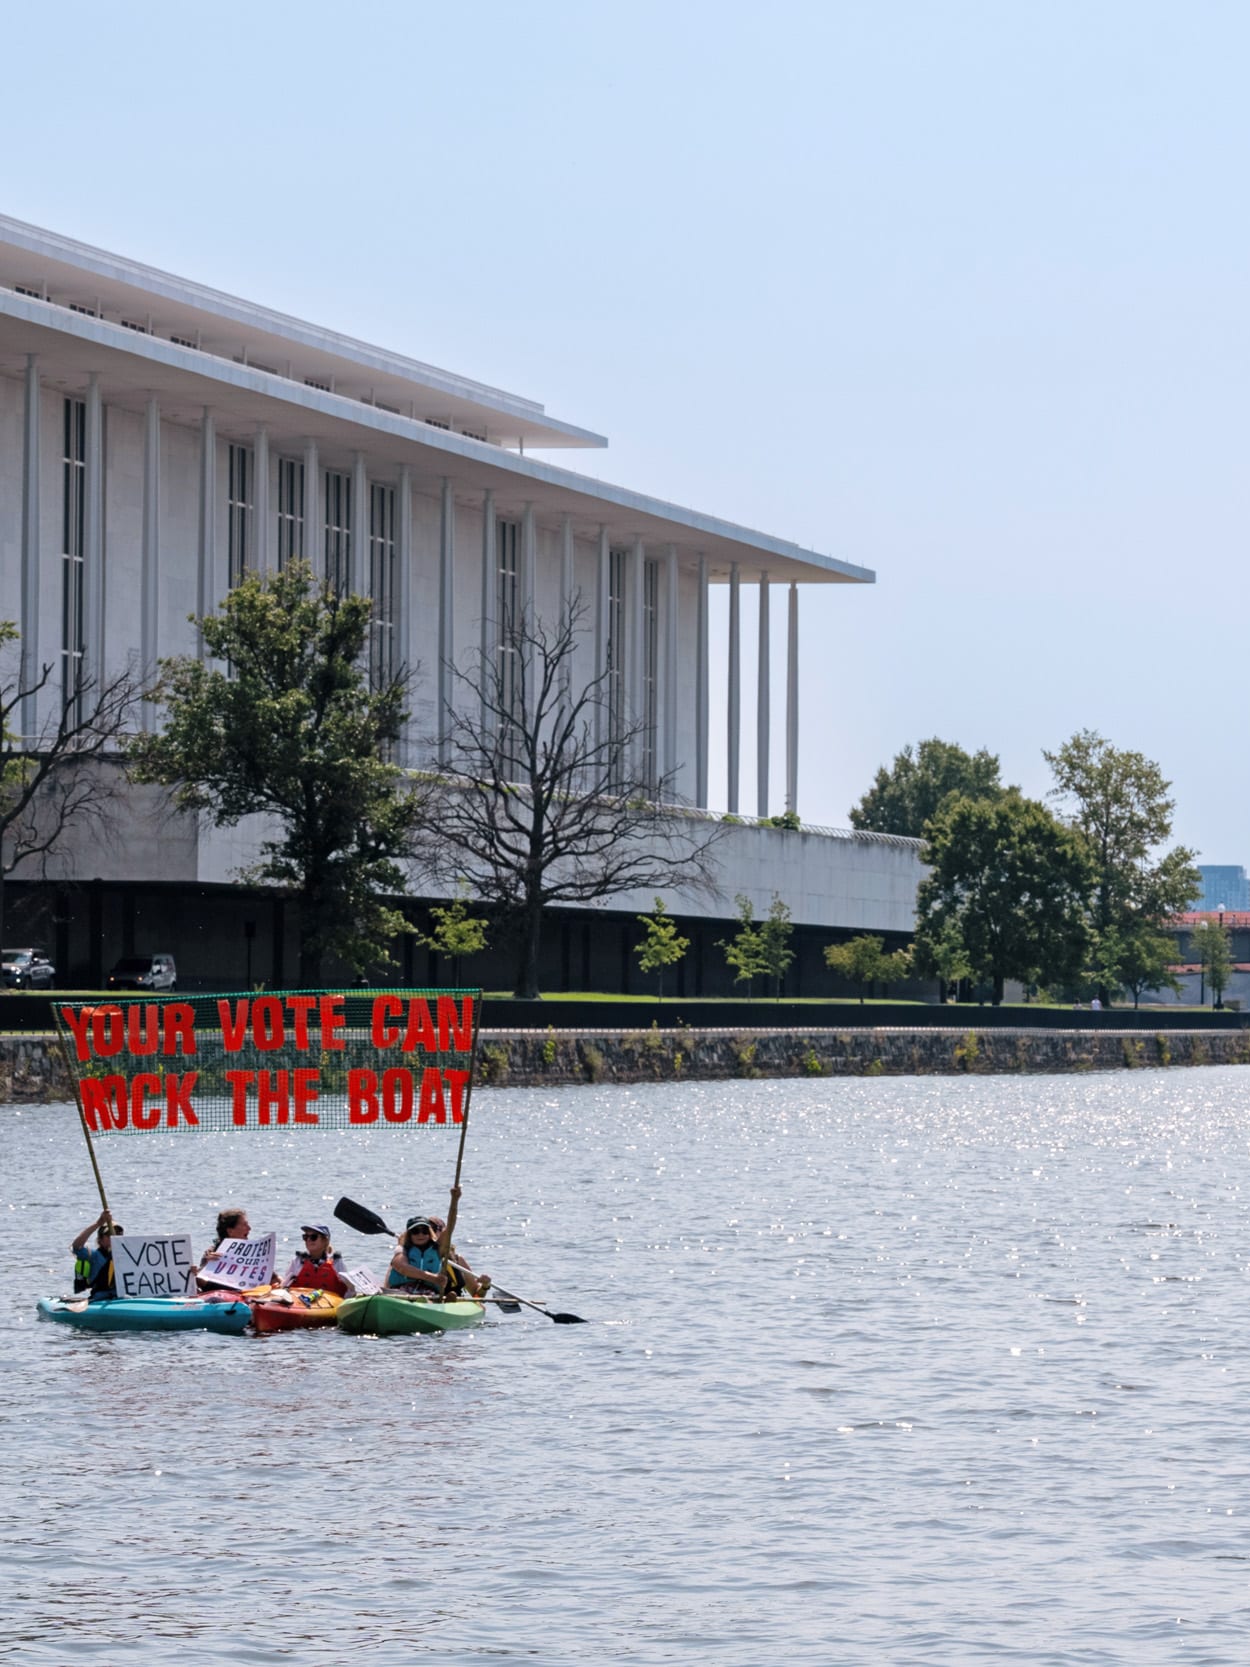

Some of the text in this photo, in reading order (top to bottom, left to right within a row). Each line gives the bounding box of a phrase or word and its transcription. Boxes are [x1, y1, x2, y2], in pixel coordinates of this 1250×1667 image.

[61, 994, 474, 1061] YOUR VOTE CAN
[79, 1067, 470, 1132] ROCK THE BOAT
[121, 1240, 189, 1267] VOTE
[227, 1238, 272, 1256] PROTECT
[214, 1261, 268, 1282] VOTES
[236, 1257, 260, 1265] OUR
[123, 1270, 191, 1296] EARLY
